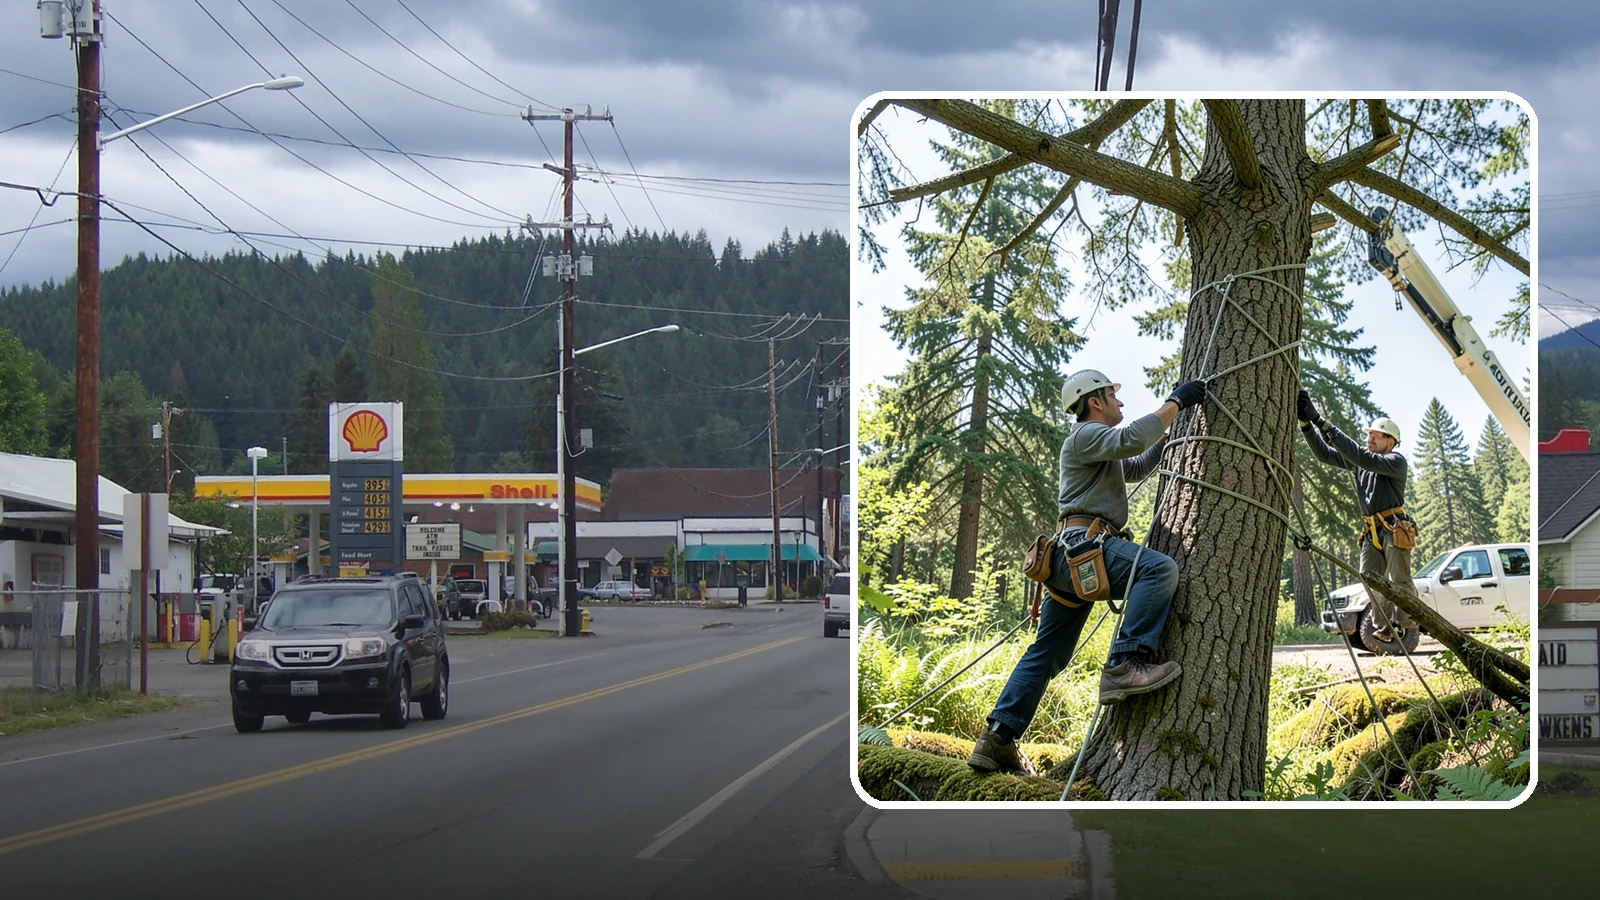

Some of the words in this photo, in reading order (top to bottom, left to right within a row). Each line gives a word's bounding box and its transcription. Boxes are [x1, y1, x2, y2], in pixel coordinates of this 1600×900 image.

[366, 480, 383, 490] 395
[490, 484, 547, 499] Shell
[366, 494, 383, 504] 405
[366, 508, 383, 518] 415
[366, 522, 383, 532] 429
[1539, 642, 1566, 666] AID
[1539, 715, 1592, 739] WKENS
